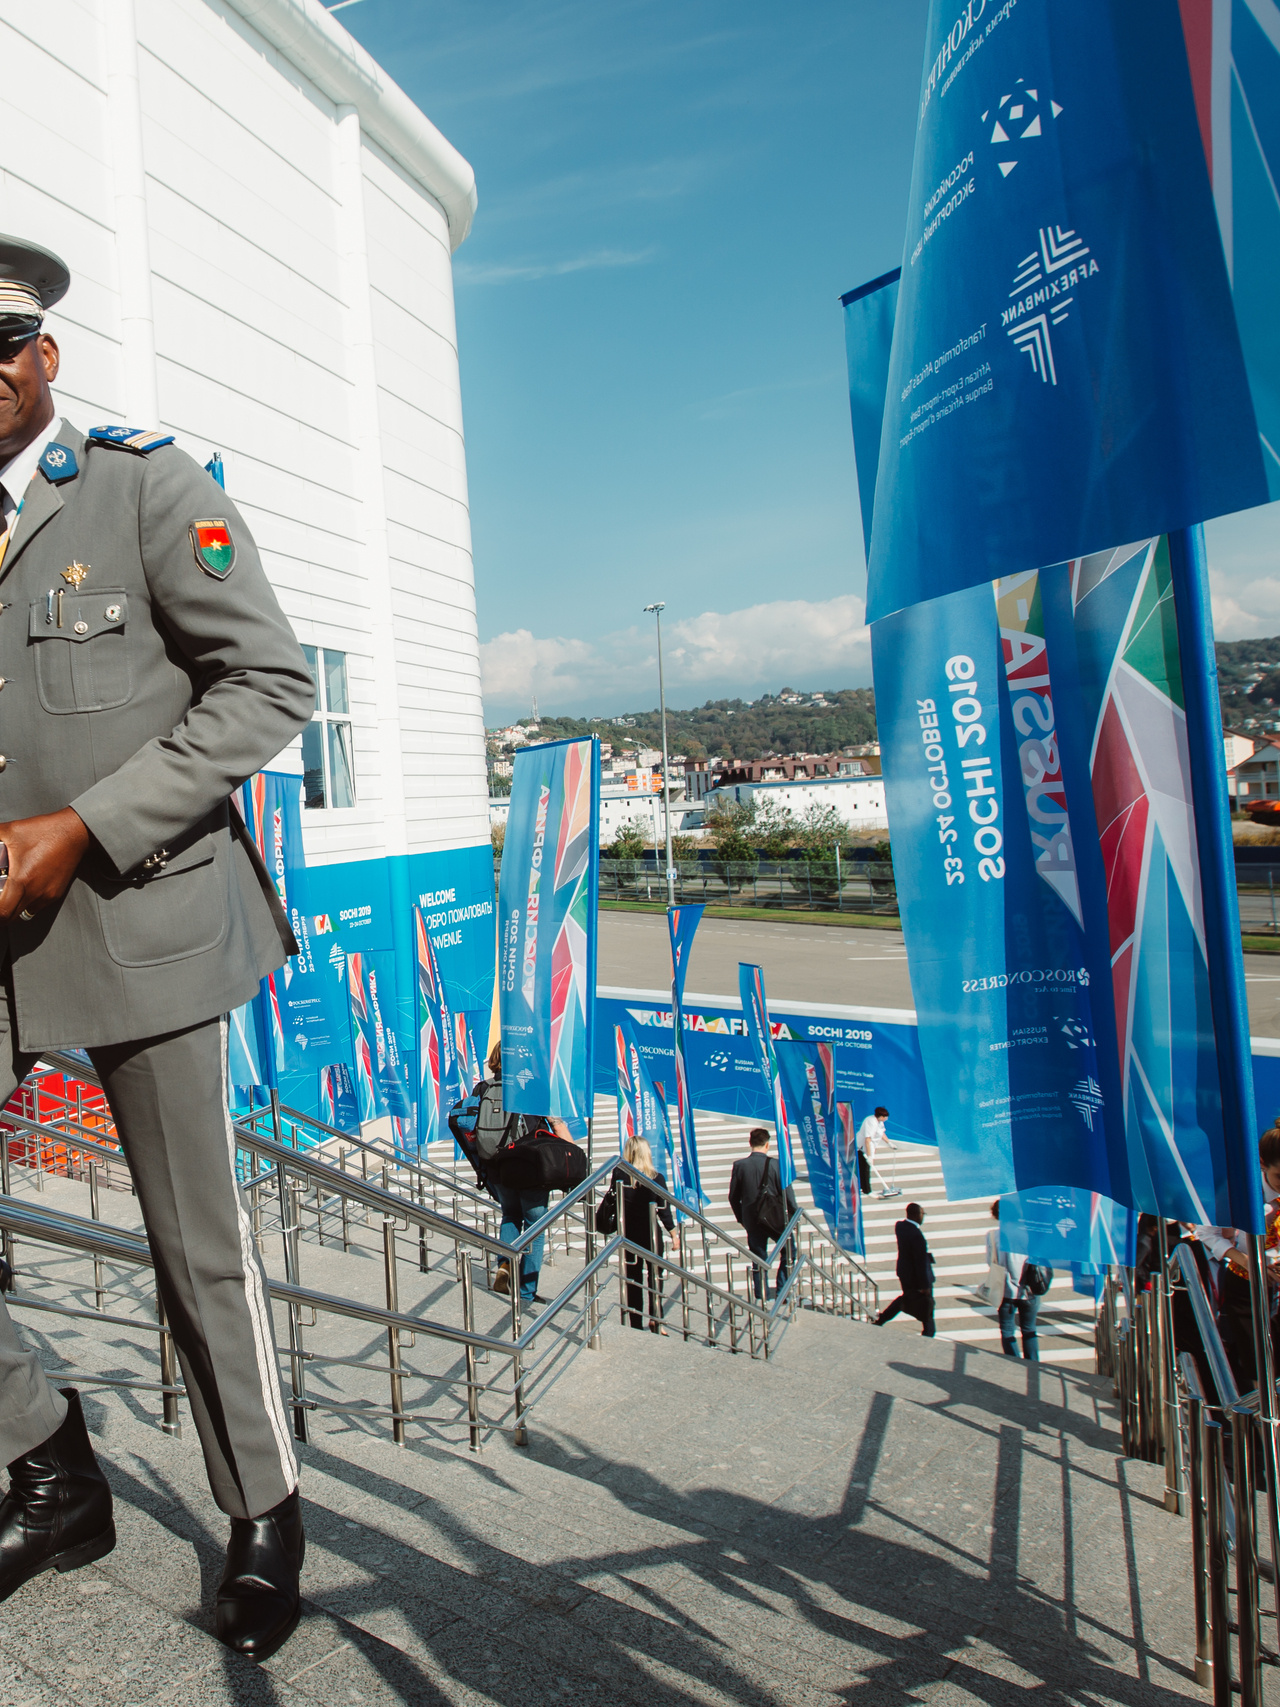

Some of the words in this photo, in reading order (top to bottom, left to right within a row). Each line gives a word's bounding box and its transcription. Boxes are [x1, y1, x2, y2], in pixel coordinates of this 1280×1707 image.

[419, 887, 456, 909] WELCOME
[291, 908, 302, 936] 2019
[339, 908, 358, 921] SOCHI
[358, 905, 372, 917] 2019
[424, 911, 447, 930] ОБРО
[447, 901, 493, 925] ПОЖАЛОВАТЬ!
[431, 929, 463, 950] NVENUE
[808, 1025, 843, 1038] SOCHI
[845, 1029, 873, 1041] 2019
[638, 1045, 676, 1057] OSCONGR
[845, 1041, 873, 1050] OCTOBER
[644, 1108, 652, 1131] SOCHI
